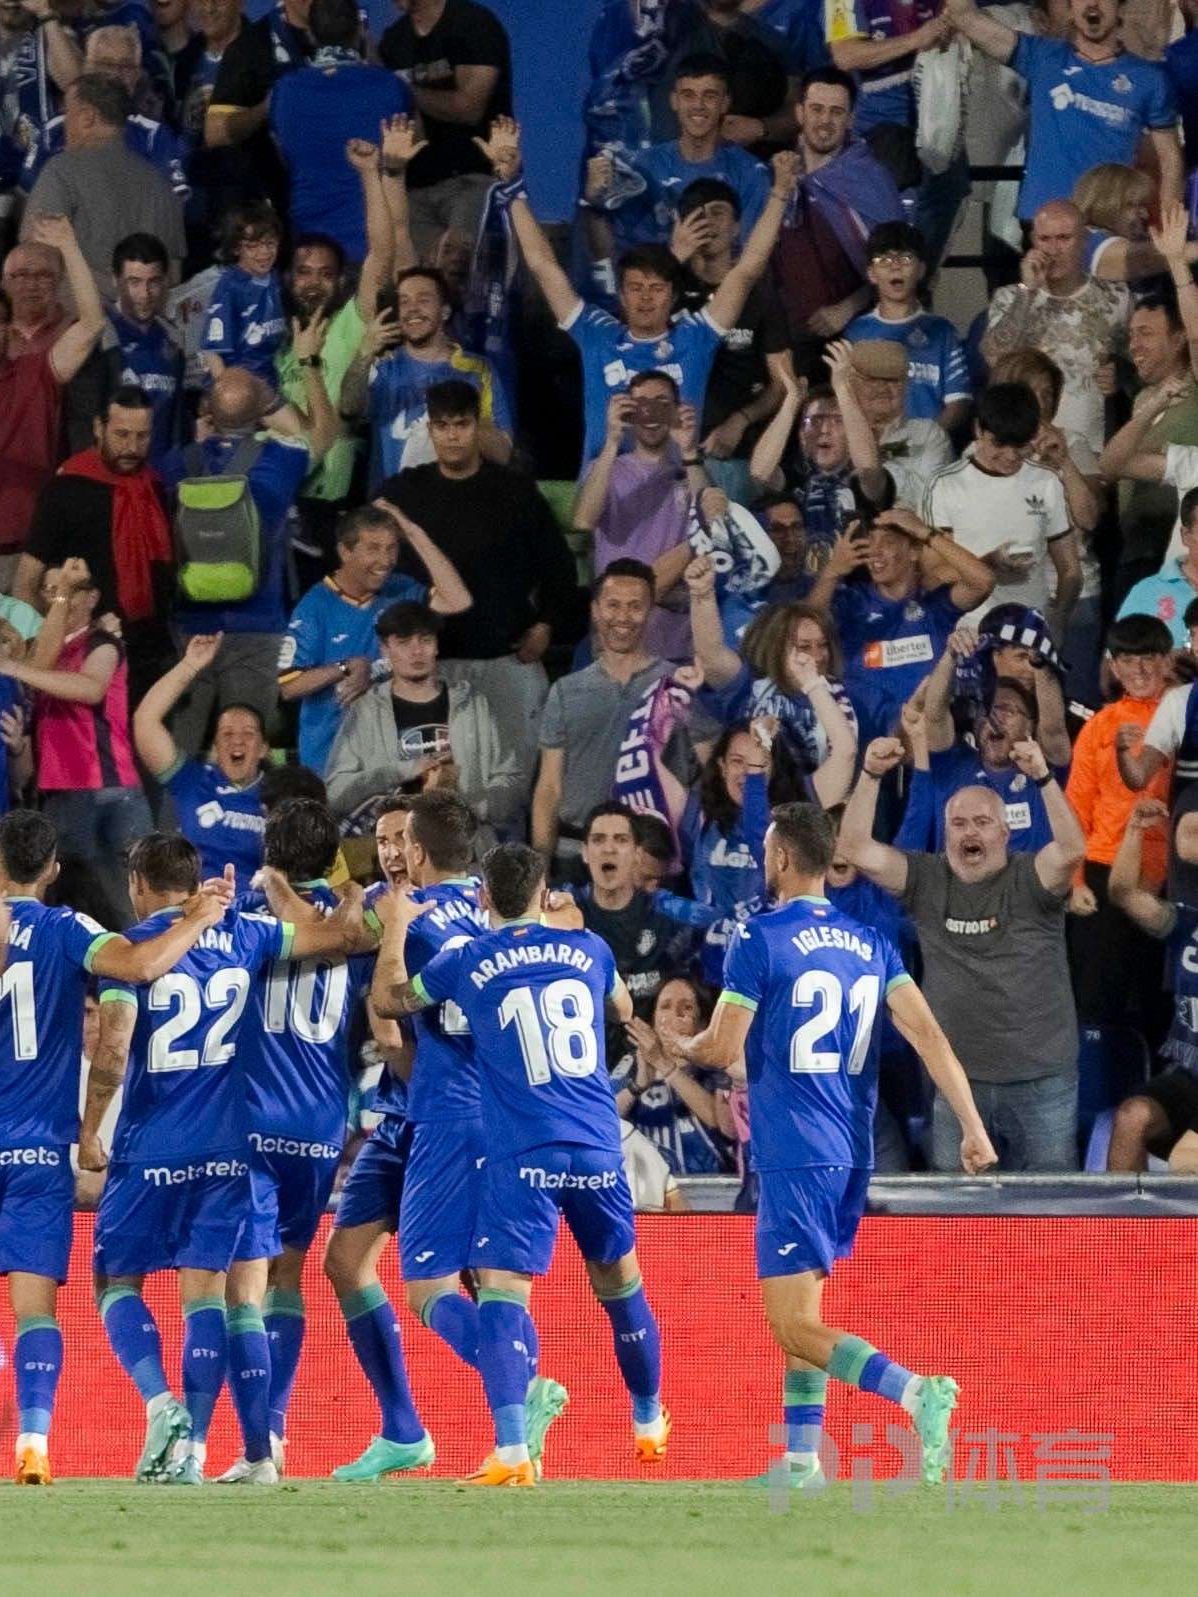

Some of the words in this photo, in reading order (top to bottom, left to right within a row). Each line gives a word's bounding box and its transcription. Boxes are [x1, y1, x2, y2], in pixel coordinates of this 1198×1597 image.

[470, 943, 594, 990] ARAMBARRI
[791, 926, 873, 963] IGLESIAS
[147, 967, 251, 1073] 22
[264, 958, 348, 1044] 10
[498, 978, 598, 1086] 18
[790, 969, 880, 1075] 21
